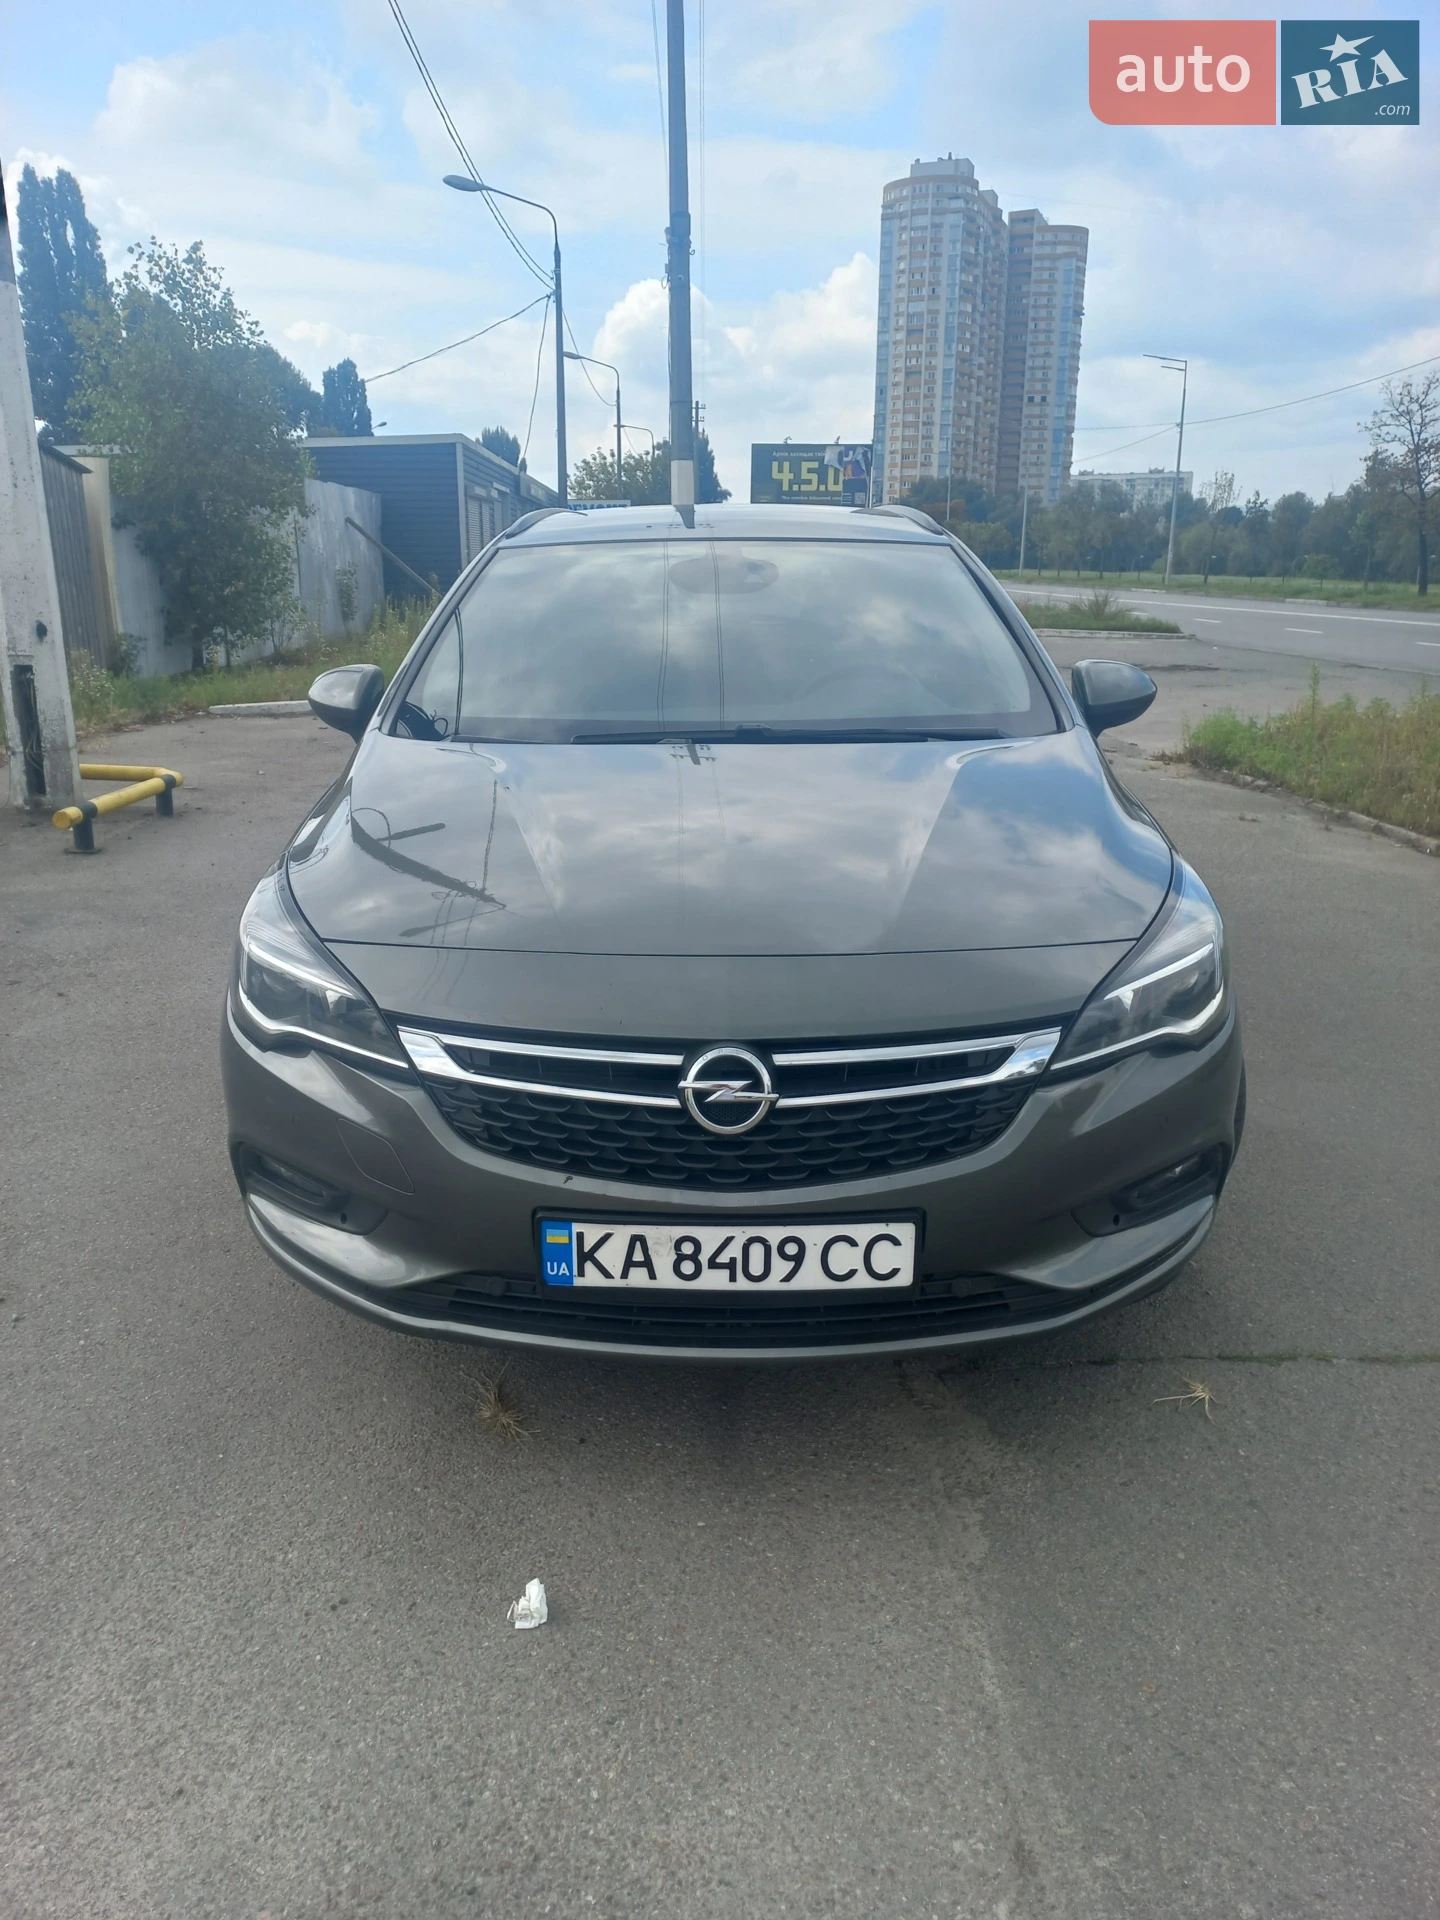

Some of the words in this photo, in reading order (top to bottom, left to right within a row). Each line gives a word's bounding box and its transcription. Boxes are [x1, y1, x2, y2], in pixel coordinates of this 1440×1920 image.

[546, 1261, 570, 1276] UA
[575, 1230, 658, 1280] KA
[672, 1234, 807, 1283] 8409
[820, 1232, 903, 1283] CC
